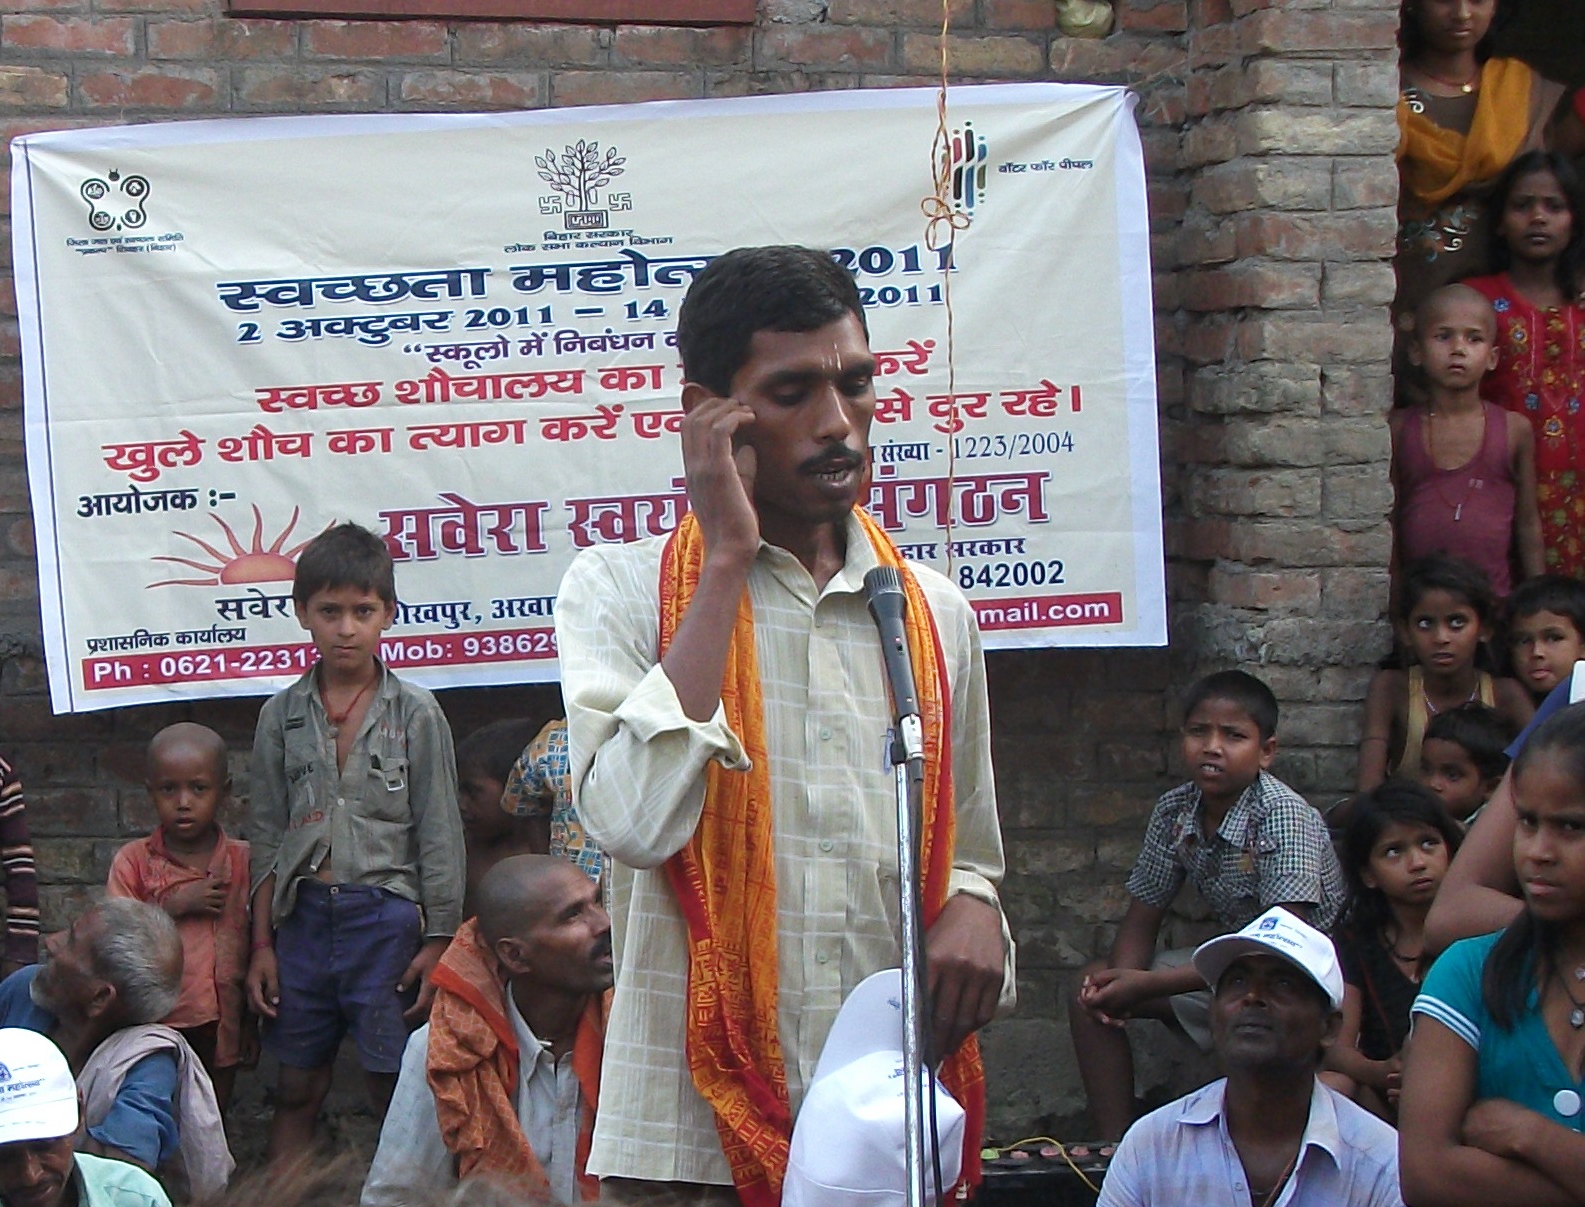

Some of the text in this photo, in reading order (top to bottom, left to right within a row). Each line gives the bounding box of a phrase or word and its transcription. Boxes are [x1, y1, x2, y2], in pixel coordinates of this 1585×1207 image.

[585, 229, 633, 238] सरकार
[216, 267, 493, 310] स्वच्छता
[830, 244, 956, 273] 2011
[237, 323, 260, 342] 2
[464, 306, 552, 328] 2011
[625, 300, 667, 319] 14
[858, 284, 942, 306] 2011
[519, 330, 546, 356] में
[554, 327, 656, 355] निबंधन
[255, 379, 383, 412] स्वच्छ
[395, 367, 584, 403] शौचालय
[600, 364, 664, 391] का
[102, 430, 205, 482] खुले
[218, 424, 312, 463] शौच
[327, 427, 393, 455] का
[408, 418, 526, 451] त्याग
[540, 404, 624, 443] करें
[881, 439, 930, 463] संख्या
[953, 431, 1075, 461] 1223/2004
[77, 484, 199, 517] आयोजक
[379, 493, 548, 561] सवेरा
[898, 538, 1026, 560] हार सरकार
[215, 588, 295, 620] सवेर
[491, 596, 558, 619] अखा
[960, 560, 1065, 589] 842002
[86, 623, 246, 655] प्रशासनिक कार्यालय
[93, 663, 131, 682] Ph
[381, 640, 453, 662] Mob:
[978, 602, 1109, 624] mail.com
